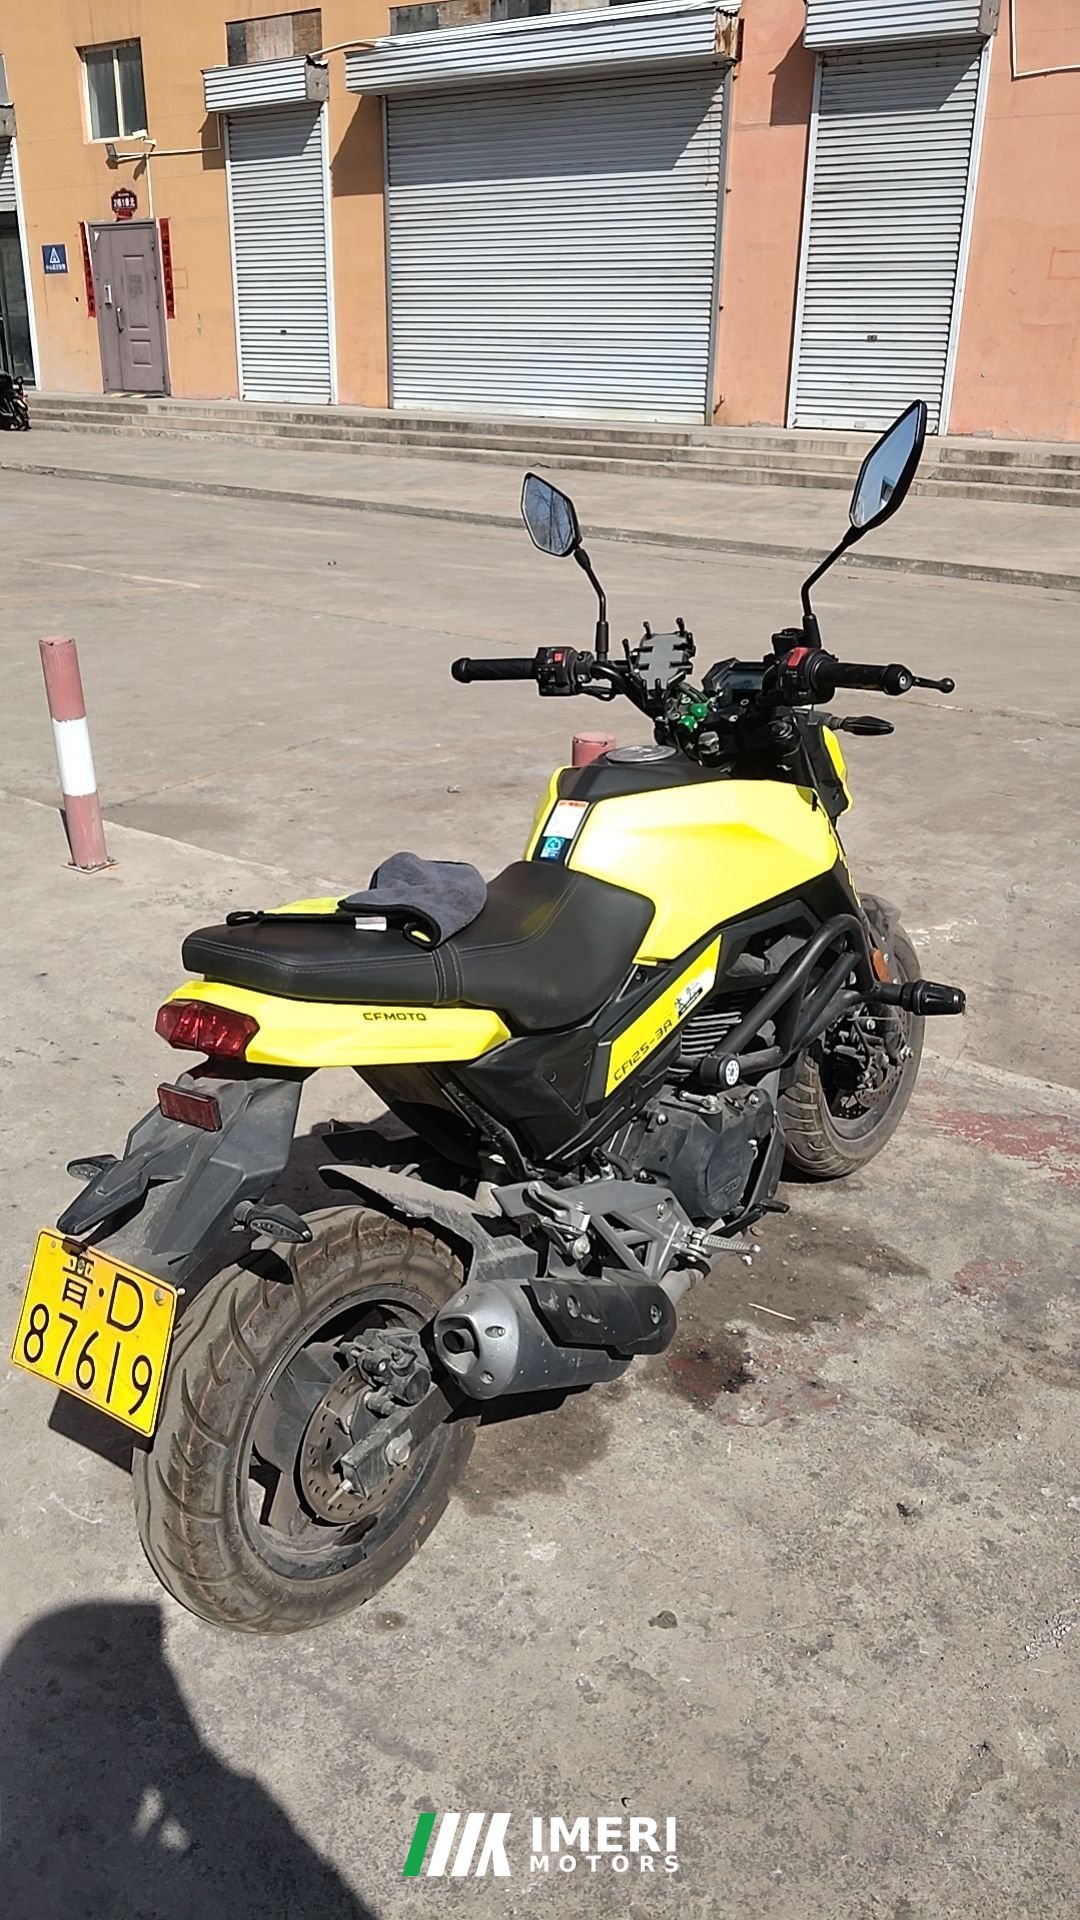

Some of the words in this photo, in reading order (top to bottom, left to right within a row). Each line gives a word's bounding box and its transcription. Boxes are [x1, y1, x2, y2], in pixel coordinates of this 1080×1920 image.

[362, 1012, 427, 1021] CFMOTO
[613, 1019, 674, 1082] CF125-3A
[23, 1303, 153, 1416] 87619
